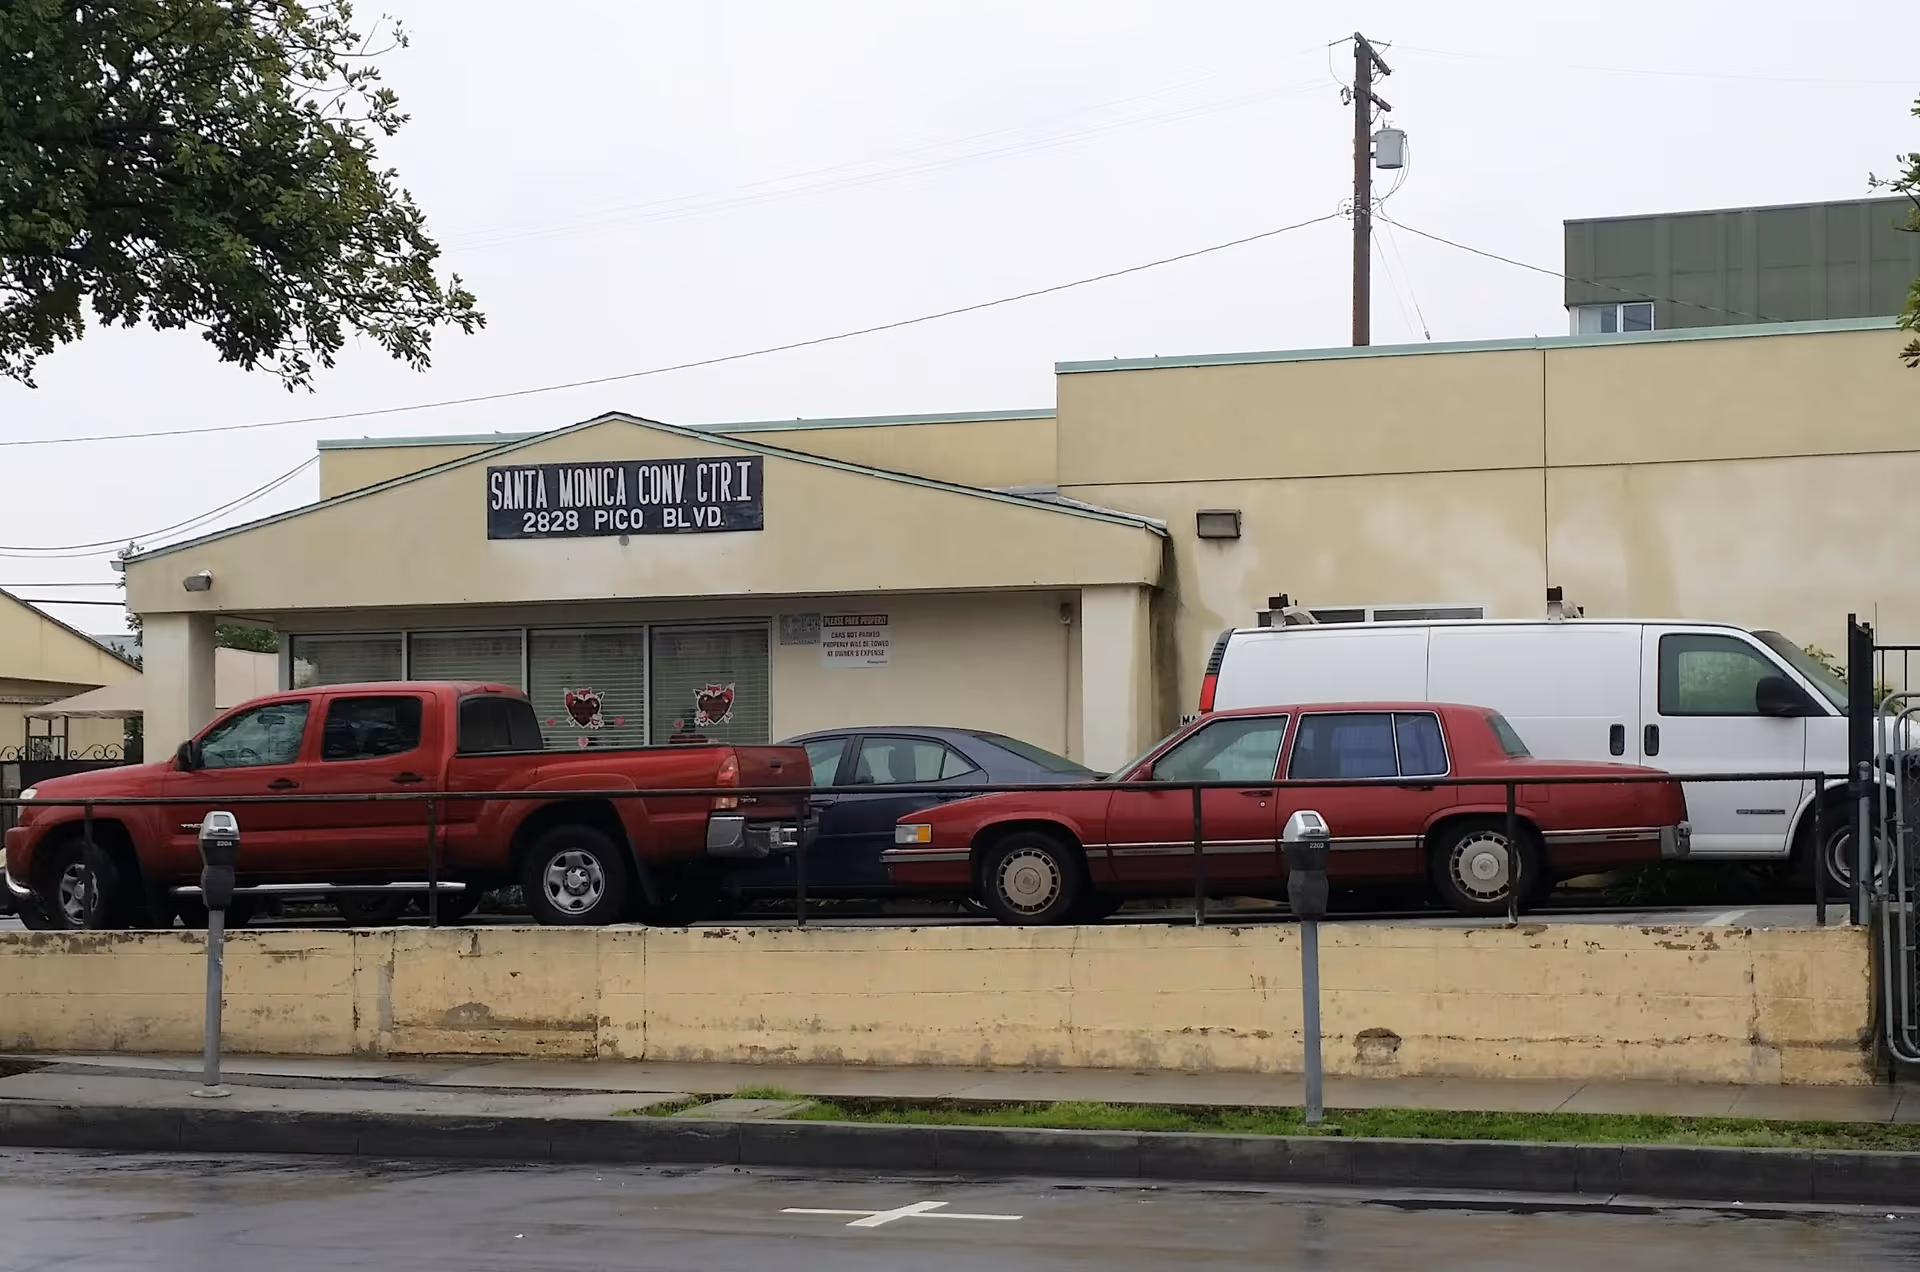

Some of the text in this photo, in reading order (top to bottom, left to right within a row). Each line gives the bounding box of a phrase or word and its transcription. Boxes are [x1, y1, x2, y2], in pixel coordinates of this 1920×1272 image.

[490, 469, 548, 510] SANTA
[559, 466, 626, 508] MONICA
[638, 464, 687, 506] CONV.
[522, 506, 725, 533] 2828 PICO BLVD.
[824, 616, 844, 626] PLEASE
[845, 616, 859, 625] PARK
[831, 631, 846, 639] CARS
